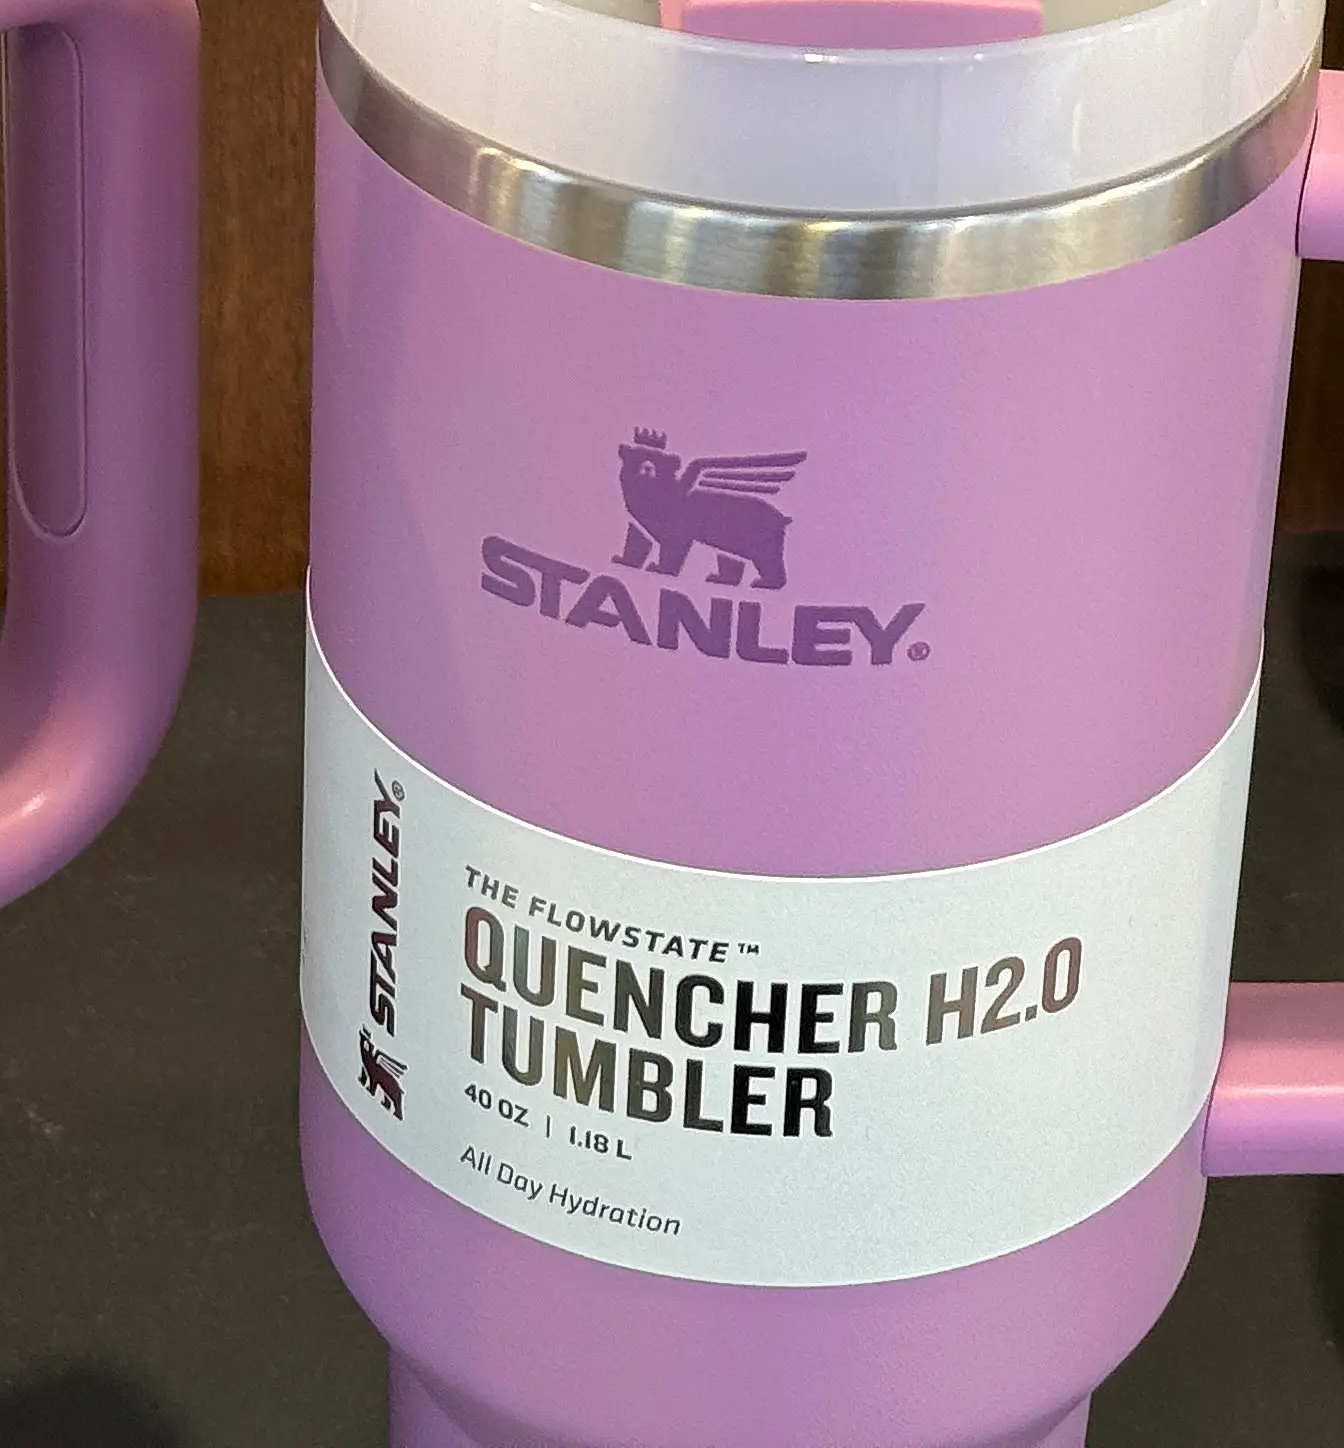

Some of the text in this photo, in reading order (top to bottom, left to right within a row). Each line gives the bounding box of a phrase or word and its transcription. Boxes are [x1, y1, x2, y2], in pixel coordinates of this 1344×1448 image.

[465, 865, 519, 909] THE
[464, 906, 1083, 1054] QUENCHER H2.0
[460, 982, 833, 1138] TUMBLER
[464, 1084, 492, 1110] 40
[498, 1099, 529, 1127] OZ
[569, 1126, 609, 1154] 1.18
[616, 1139, 632, 1160] L
[459, 1145, 681, 1236] All Day Hydration
